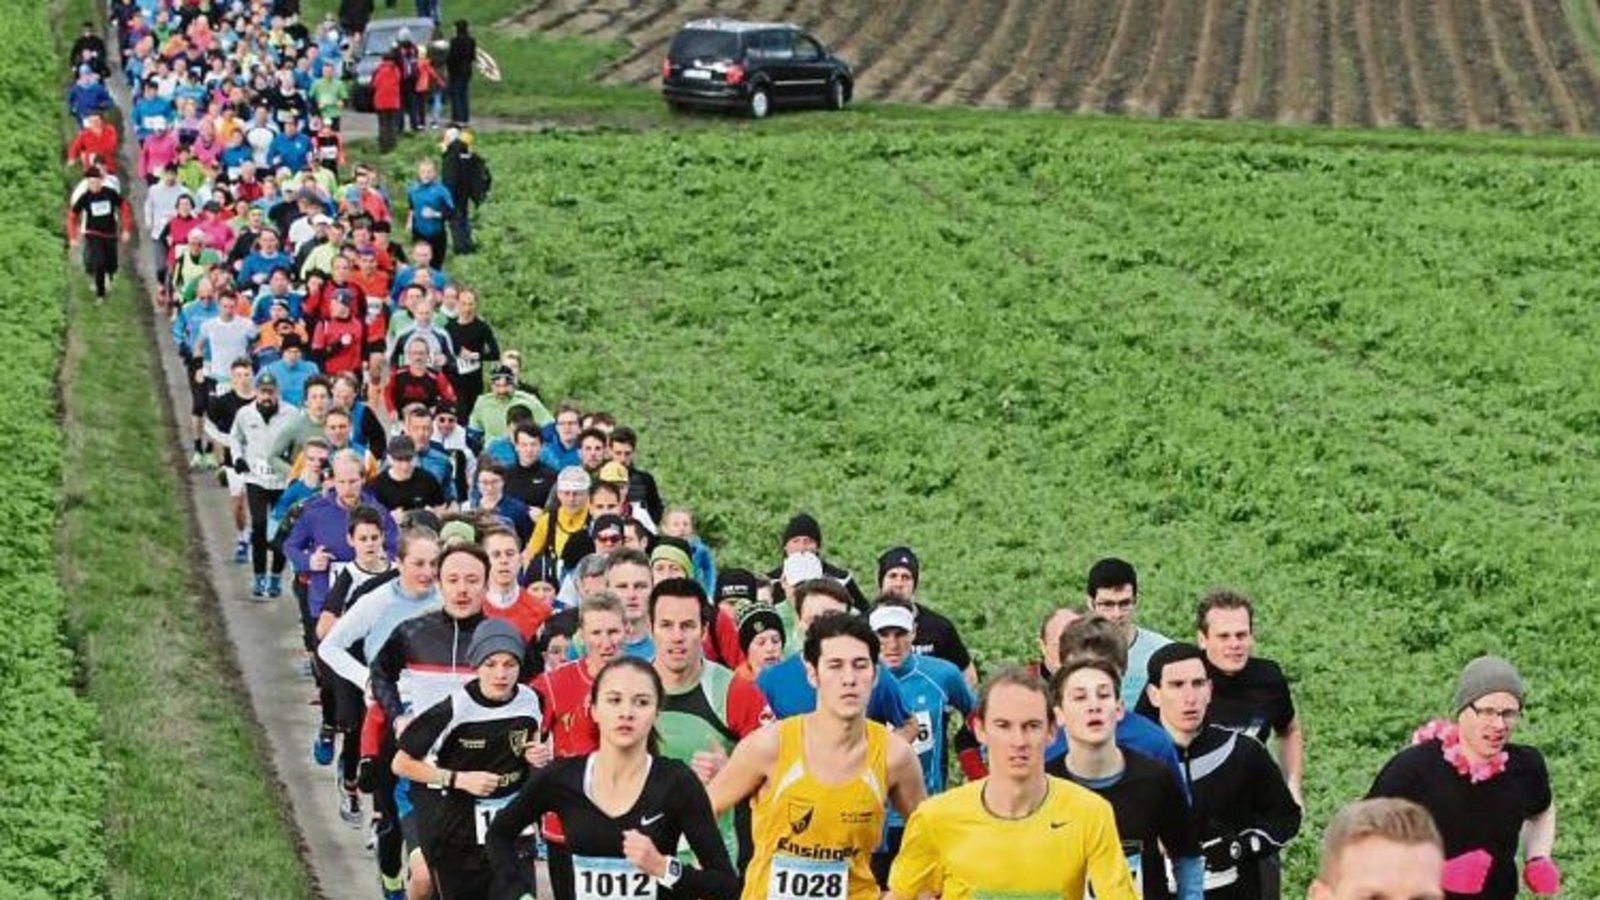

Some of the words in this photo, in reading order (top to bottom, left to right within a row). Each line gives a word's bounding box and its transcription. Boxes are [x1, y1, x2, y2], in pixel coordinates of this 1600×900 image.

[777, 836, 859, 860] Ensinger
[580, 870, 651, 897] 1012
[776, 870, 842, 898] 1028
